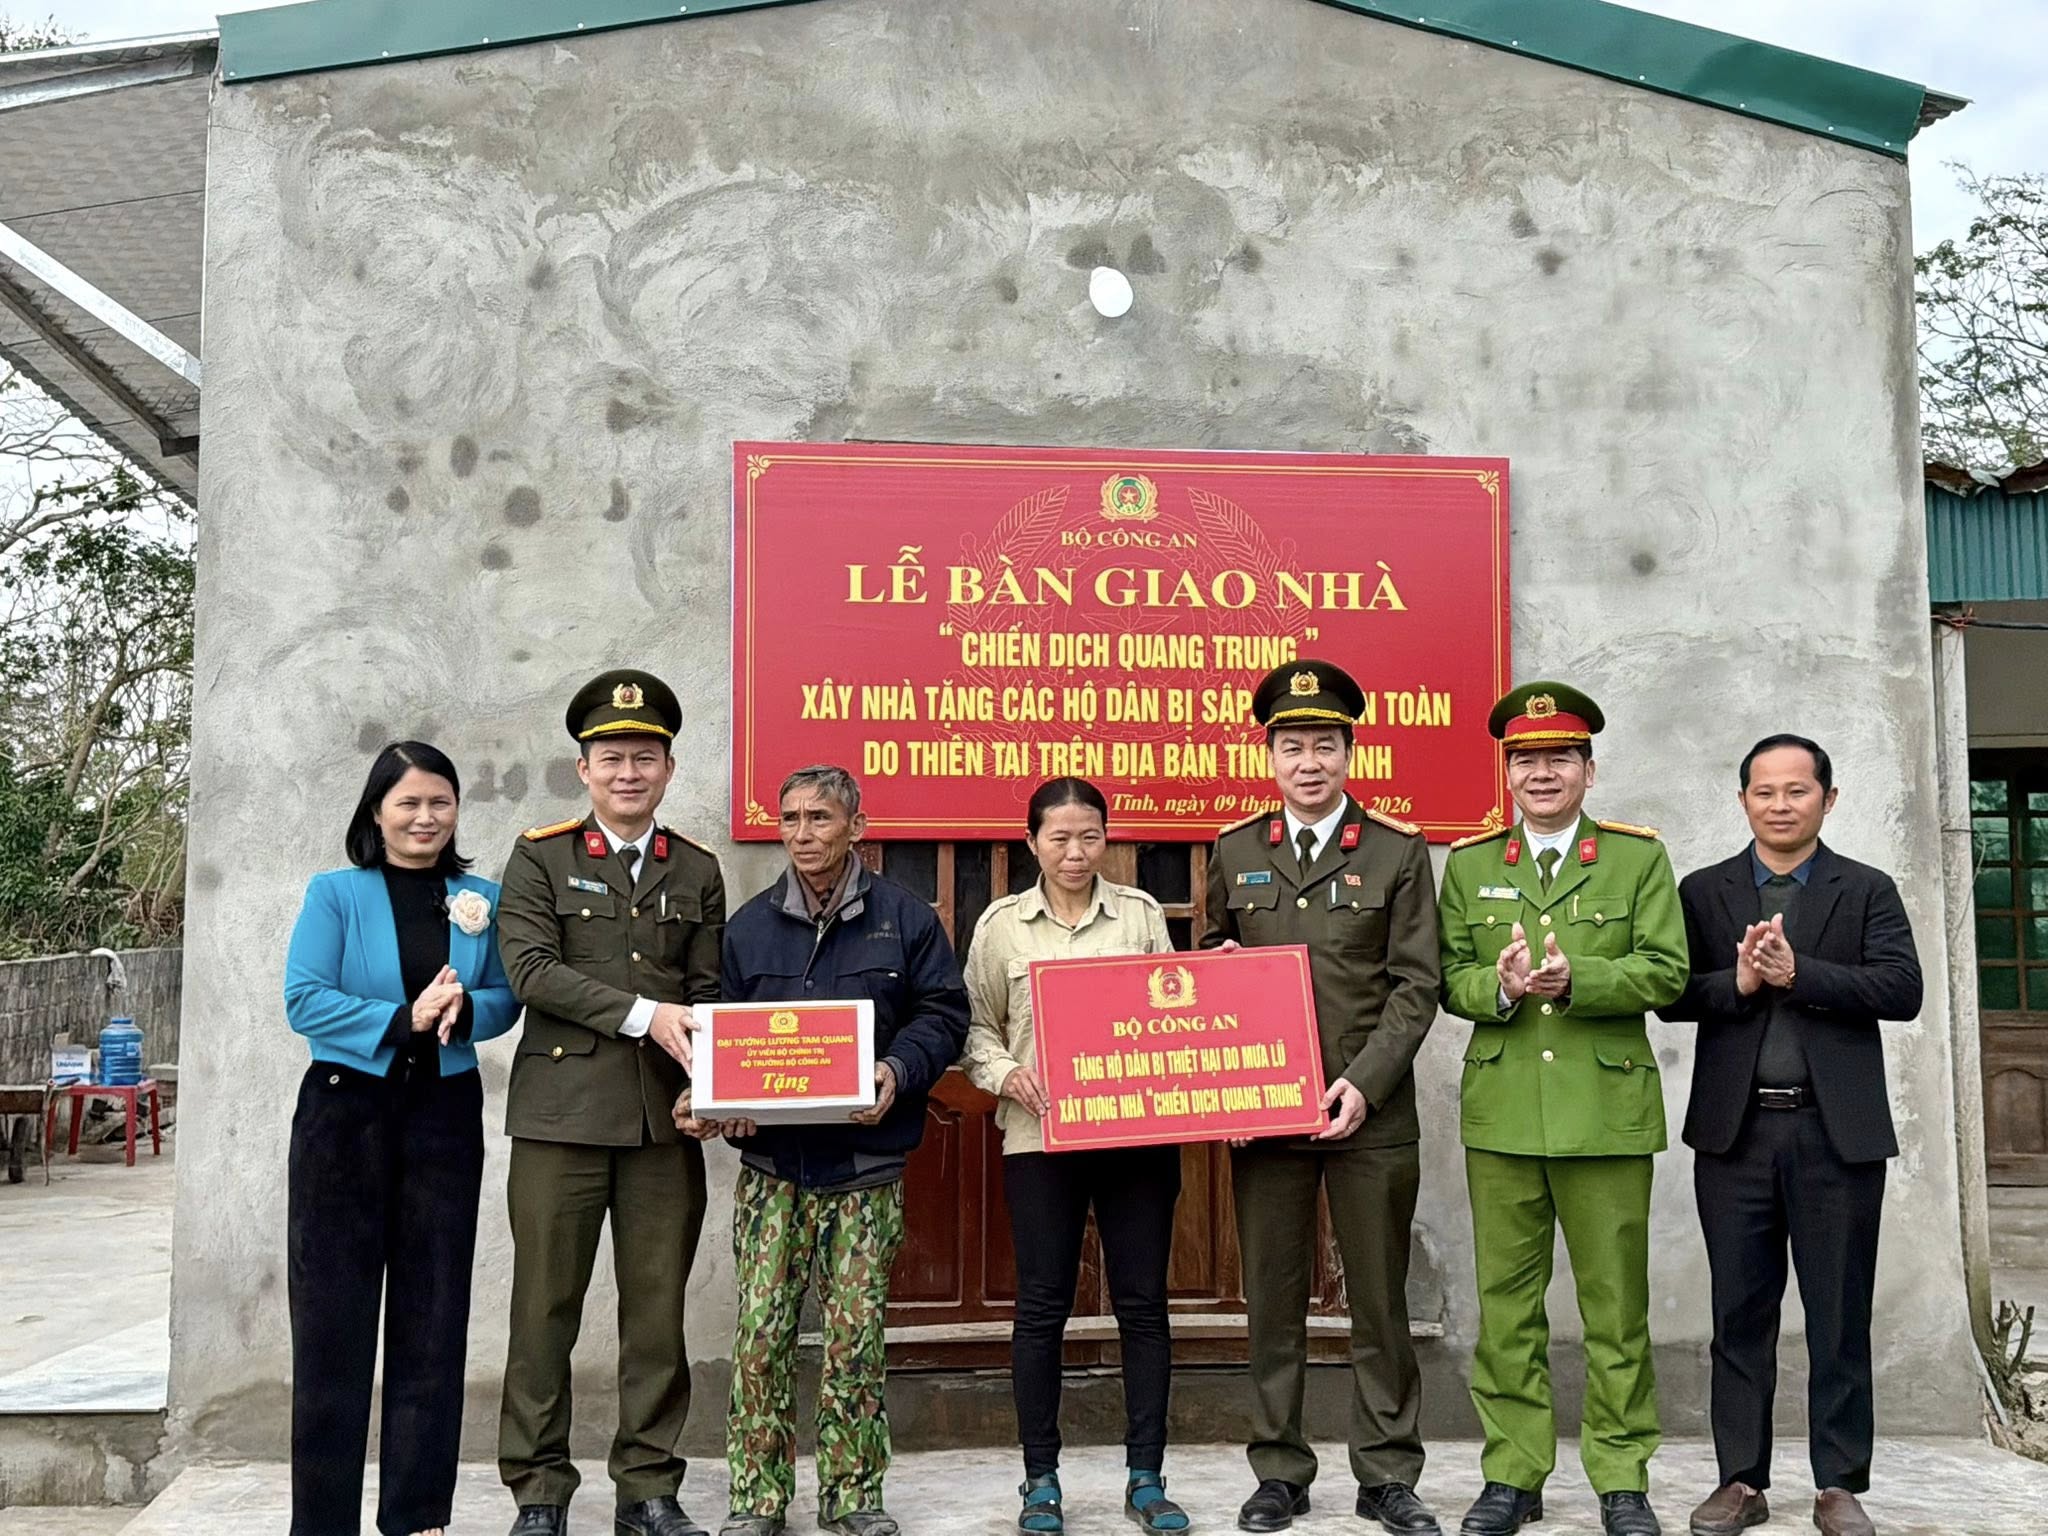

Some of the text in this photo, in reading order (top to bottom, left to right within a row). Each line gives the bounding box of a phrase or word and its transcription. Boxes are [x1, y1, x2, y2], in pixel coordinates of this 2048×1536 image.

[1060, 527, 1198, 550] BỘ CÔNG AN
[844, 544, 1409, 611] LỄ BÀN GIAO NHÀ
[1049, 632, 1110, 675] DỊCH
[1118, 633, 1204, 672] QUANG
[801, 677, 853, 720] XÂY
[861, 678, 917, 721] NHÀ
[924, 679, 994, 729] TẶNG
[1002, 679, 1054, 722] CÁC
[1063, 680, 1098, 729] HỘ
[1106, 681, 1160, 723] DÂN
[1167, 687, 1193, 731] BỊ
[1384, 684, 1452, 727] TOÀN
[864, 740, 900, 776] DO
[907, 734, 984, 777] THIÊN
[991, 741, 1029, 777] TAI
[1038, 735, 1104, 778] TRÊN
[1112, 742, 1156, 785] ĐỊA
[1164, 735, 1218, 779] BÀN
[1224, 732, 1276, 779] TỈN
[1111, 793, 1159, 813] Tĩnh,
[1164, 794, 1210, 816] ngày
[1214, 794, 1237, 811] 09
[1241, 794, 1282, 812] thán
[1371, 795, 1413, 814] 2026
[717, 1039, 732, 1048] ĐẠI
[821, 1035, 854, 1045] QUANG
[1112, 1013, 1239, 1040] BỘ CÔNG AN
[1072, 1038, 1287, 1086] TẶNG HỘ DÂN BỊ THIỆT HẠI DO MƯA LŨ
[762, 1072, 810, 1094] Tặng
[1058, 1092, 1082, 1124] XÂY
[1084, 1093, 1118, 1126] DỰNG
[1119, 1088, 1146, 1119] NHÀ
[1190, 1088, 1220, 1119] DỊCH
[1221, 1085, 1262, 1114] QUANG
